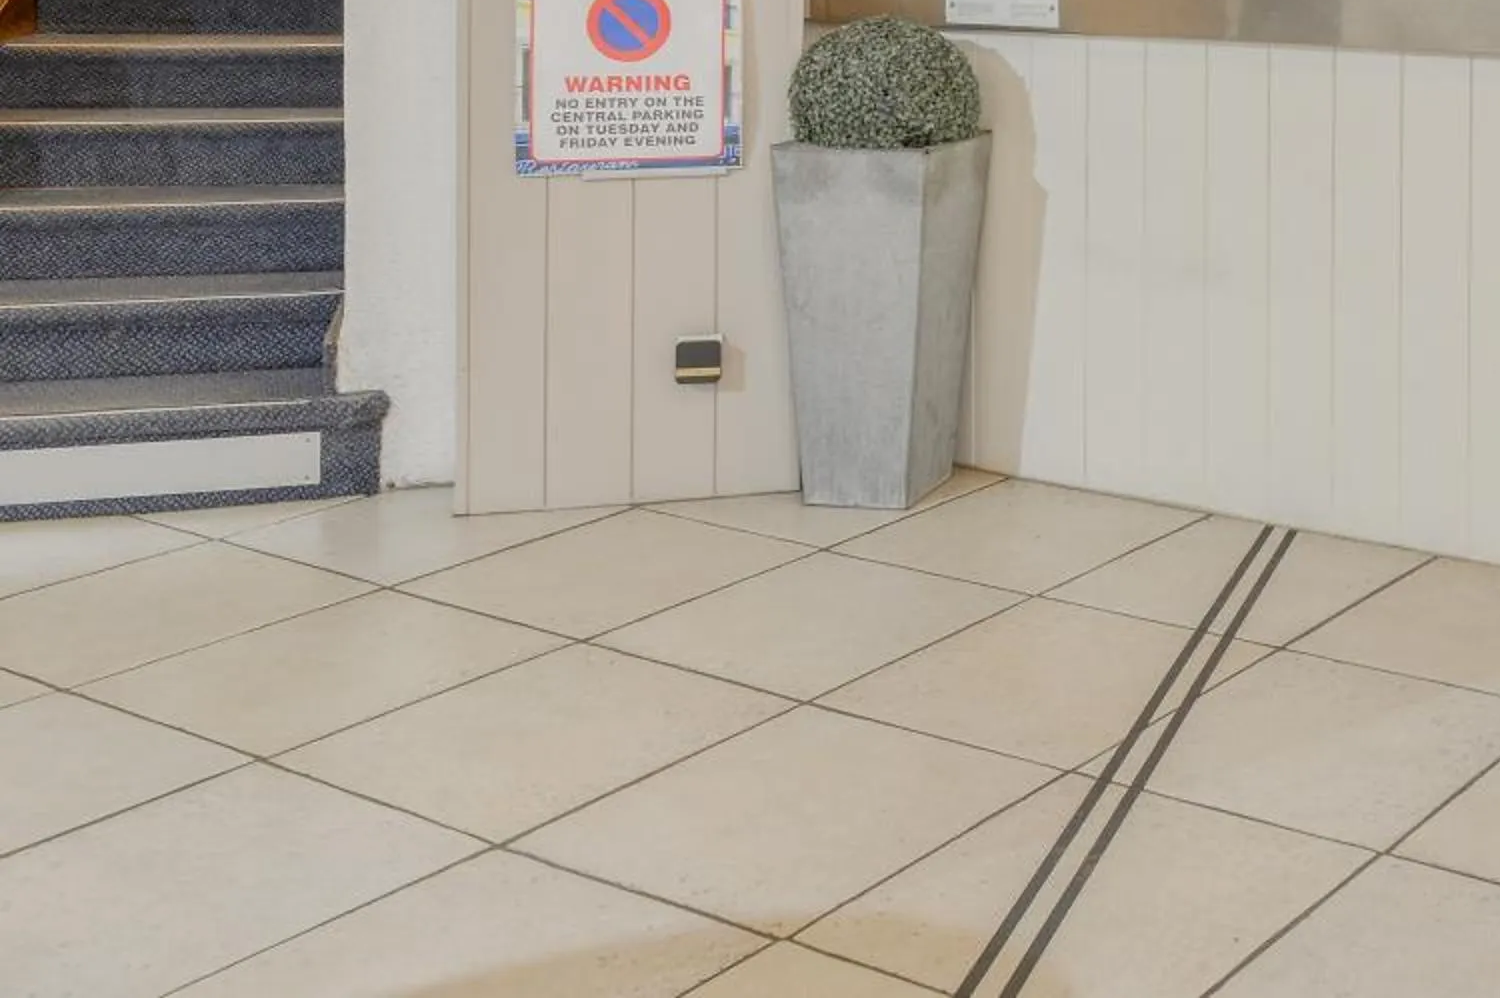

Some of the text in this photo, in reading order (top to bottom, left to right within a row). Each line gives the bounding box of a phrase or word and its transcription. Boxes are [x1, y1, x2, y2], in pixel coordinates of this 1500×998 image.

[564, 75, 692, 93] WARNING
[555, 96, 705, 109] NO ENTRY ON THE
[550, 109, 705, 122] CENTRAL PARKING
[556, 122, 699, 135] ON TUESDAY AND
[559, 135, 697, 148] FRIDAY EVENING
